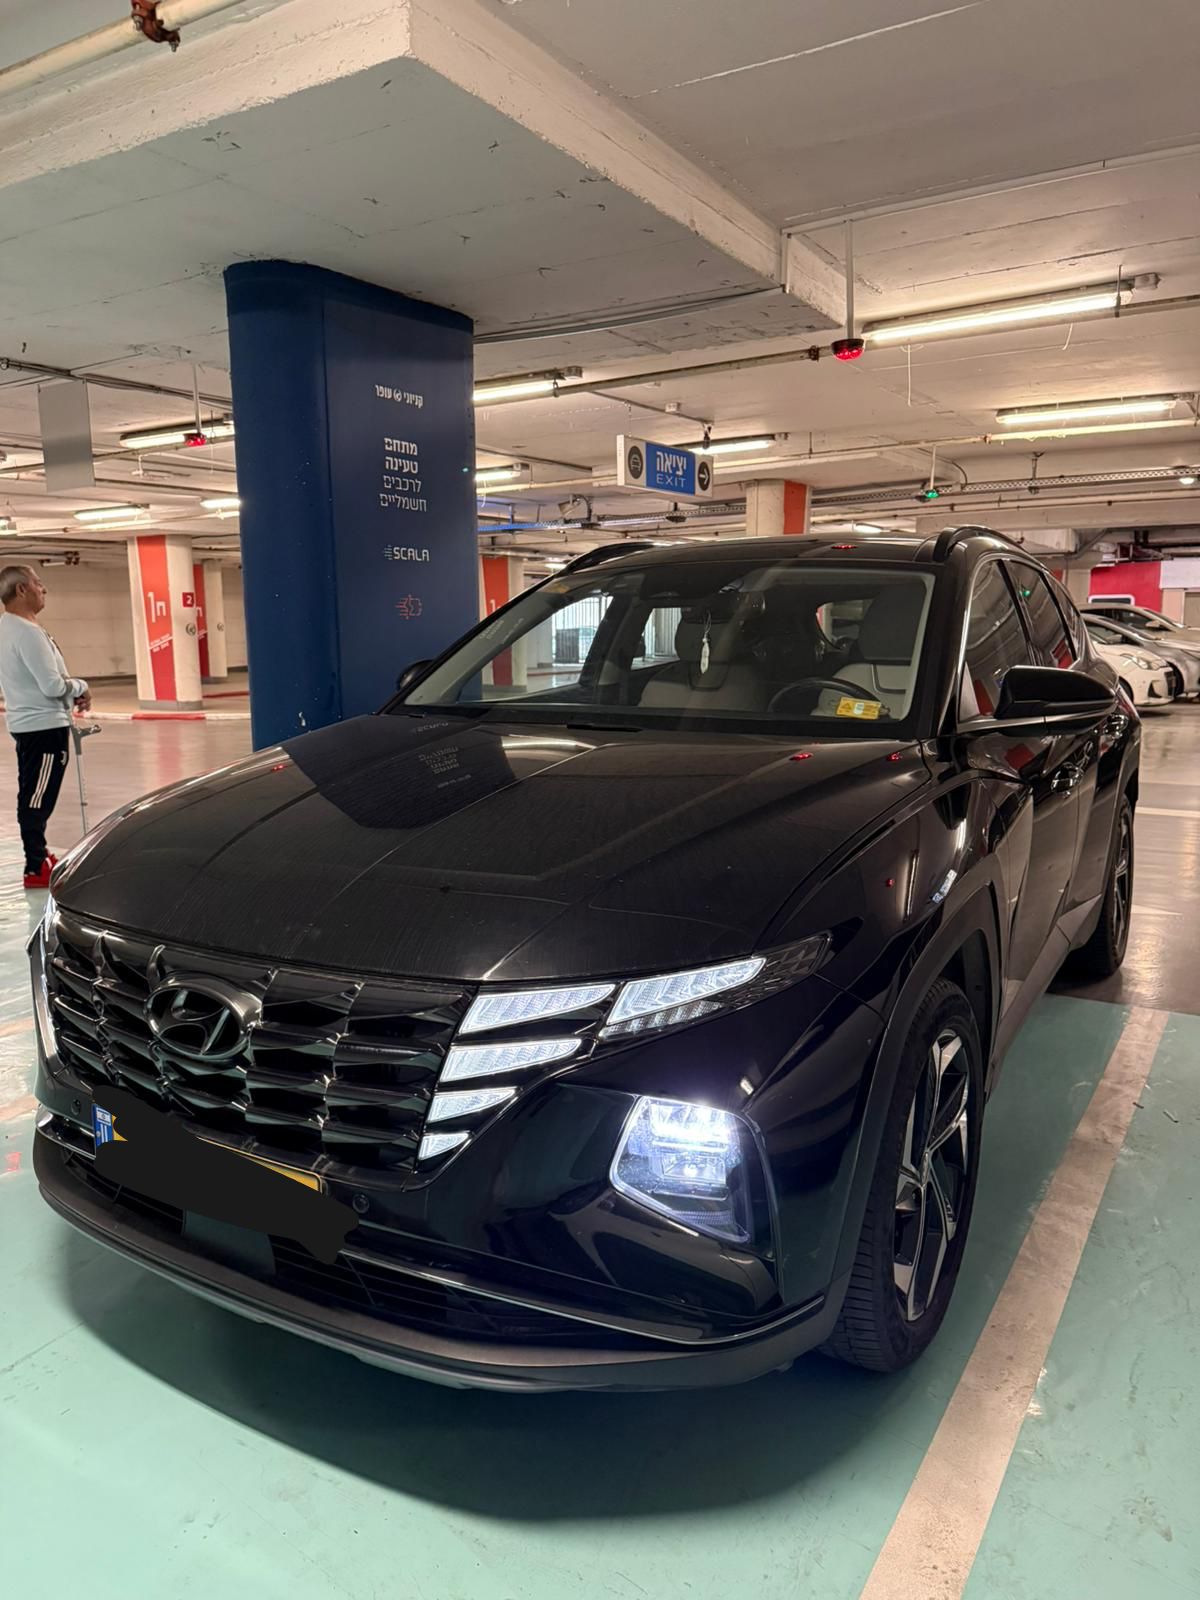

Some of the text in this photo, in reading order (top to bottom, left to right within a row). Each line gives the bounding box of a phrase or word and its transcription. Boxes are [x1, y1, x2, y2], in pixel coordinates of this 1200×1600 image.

[375, 385, 424, 408] קניוני עופר
[384, 437, 418, 456] מתחם
[385, 456, 419, 474] טעינה
[656, 450, 687, 476] יציאה
[383, 475, 422, 493] לרכבים
[656, 473, 686, 488] EXIT
[379, 493, 427, 512] חשמליים
[393, 546, 430, 562] SCALA
